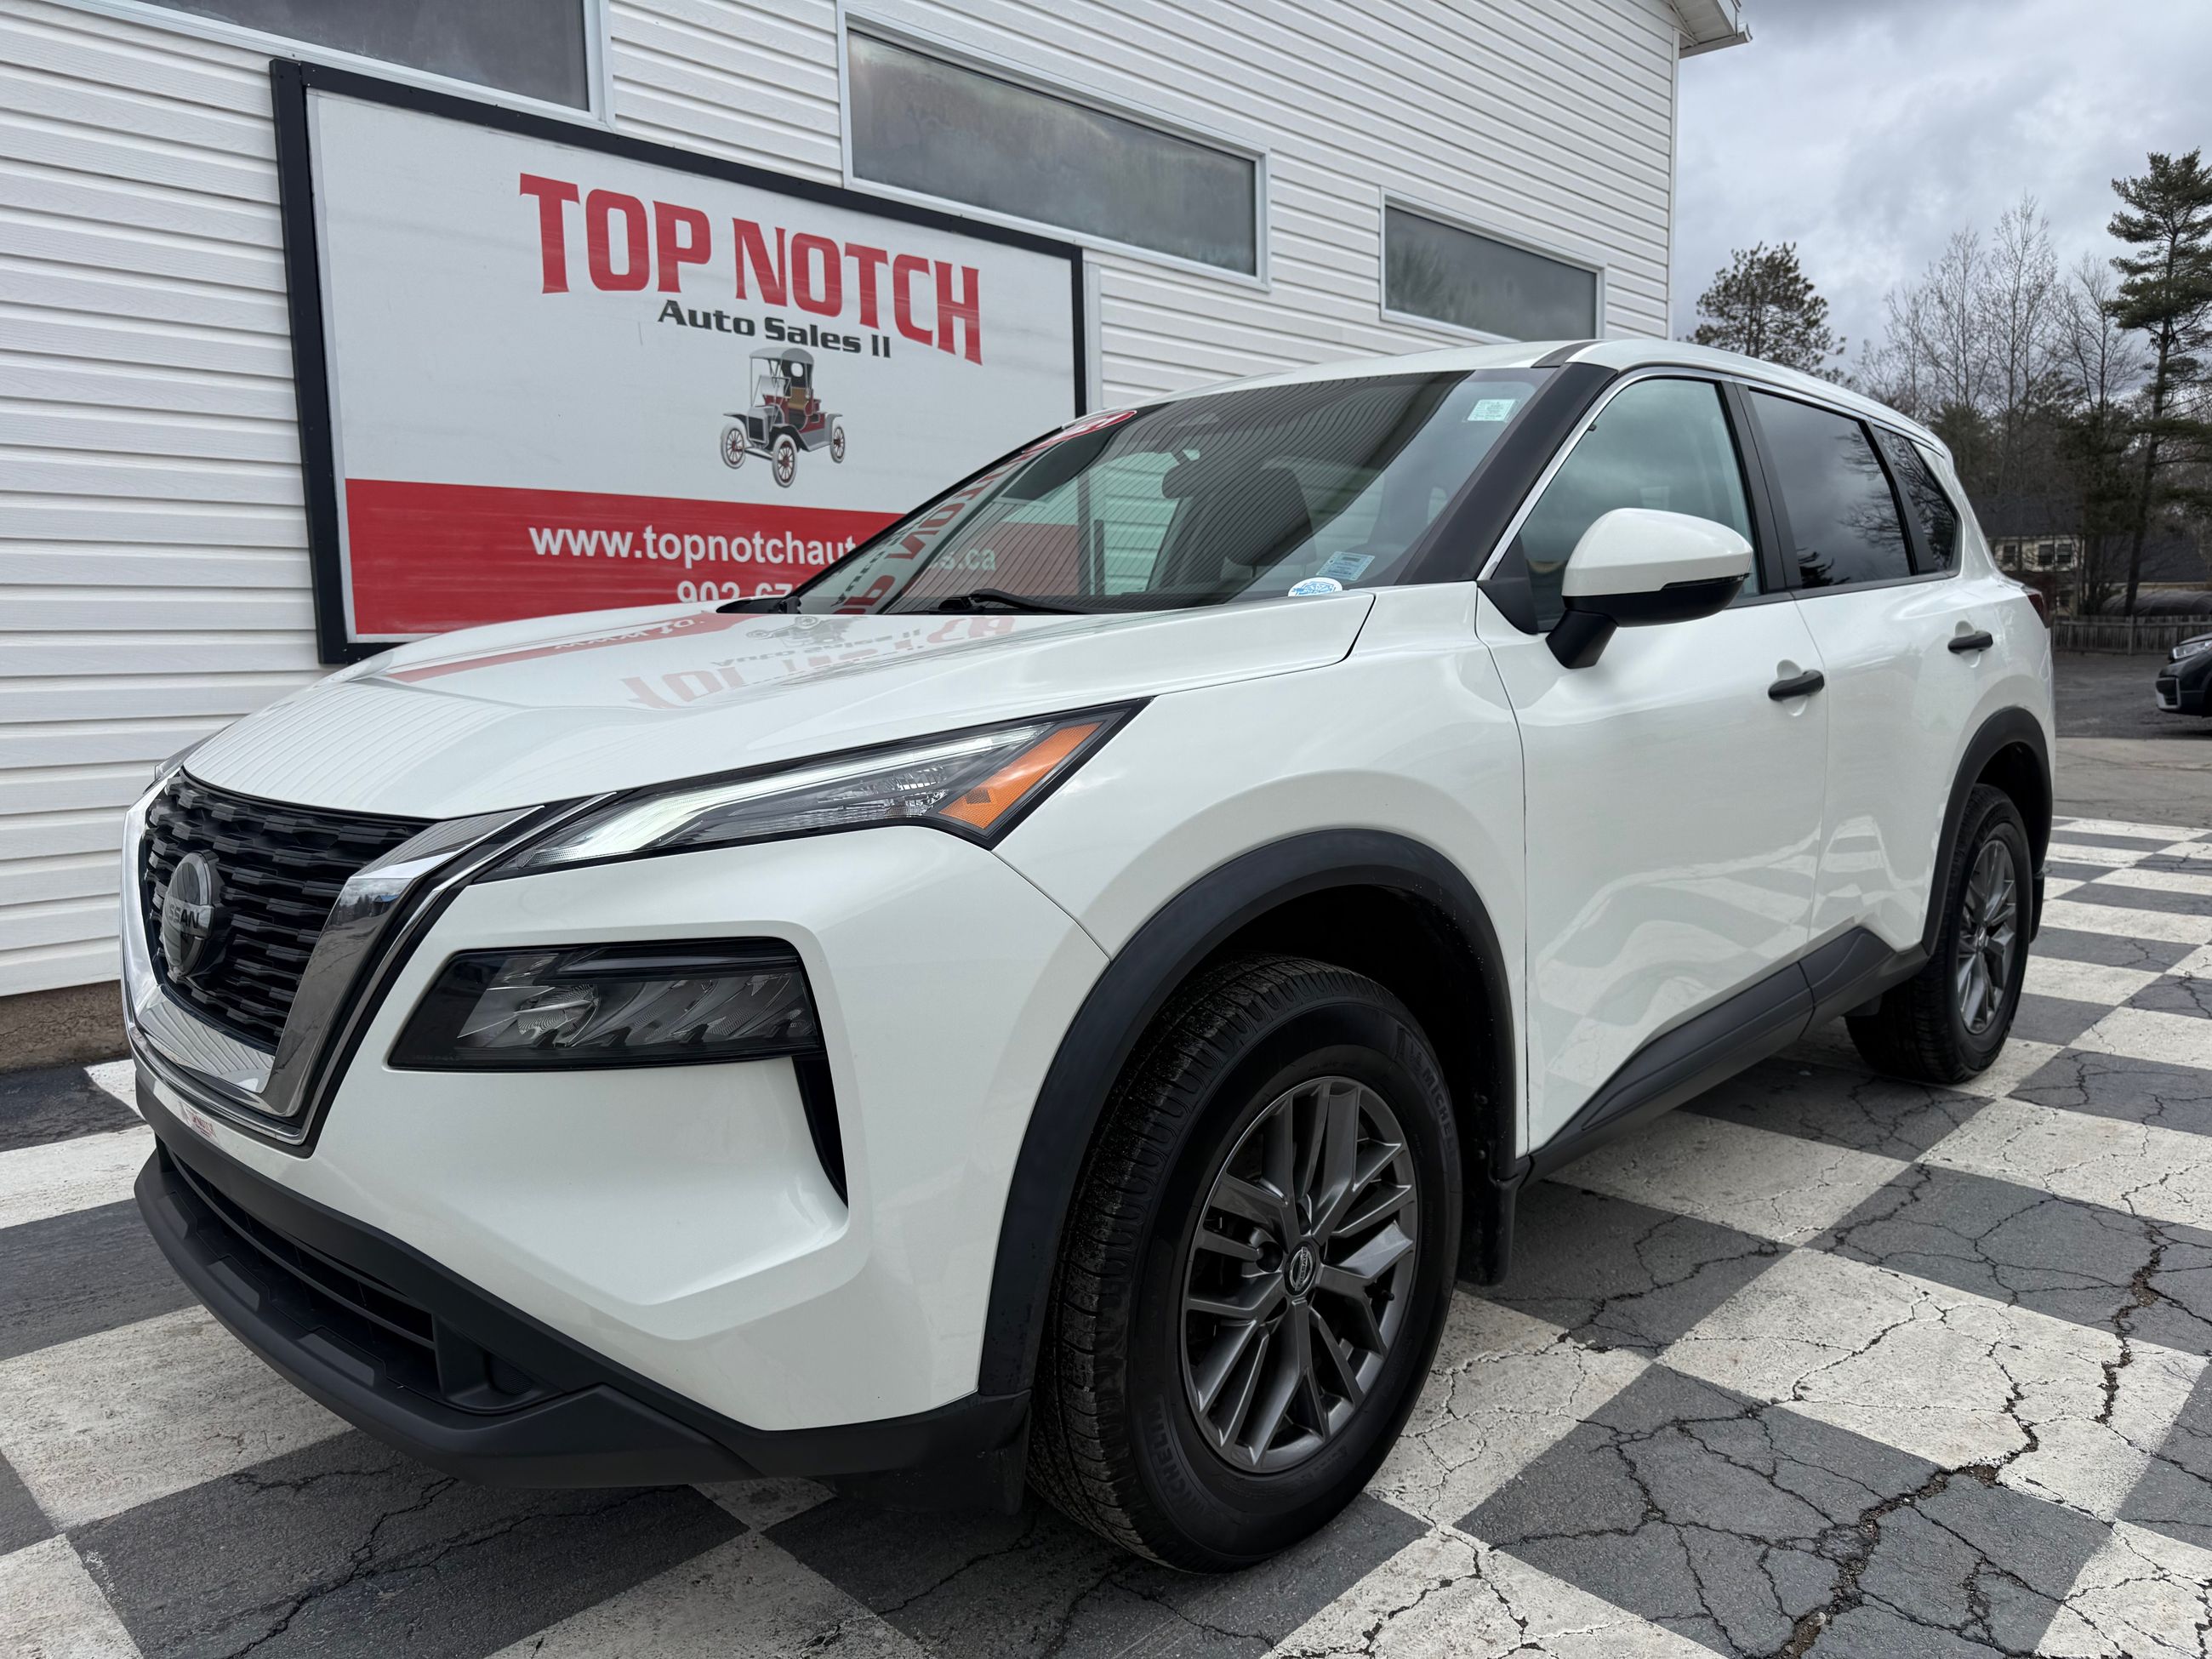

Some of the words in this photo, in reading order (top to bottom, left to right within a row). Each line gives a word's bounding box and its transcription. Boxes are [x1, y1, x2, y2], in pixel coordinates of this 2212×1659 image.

[520, 173, 711, 294] TOP
[733, 218, 983, 366] NOTCH
[658, 299, 756, 337] Auto
[765, 317, 861, 355] Sales
[871, 334, 891, 358] II
[169, 904, 200, 929] SSAN
[1422, 1067, 1457, 1171] MICHELI
